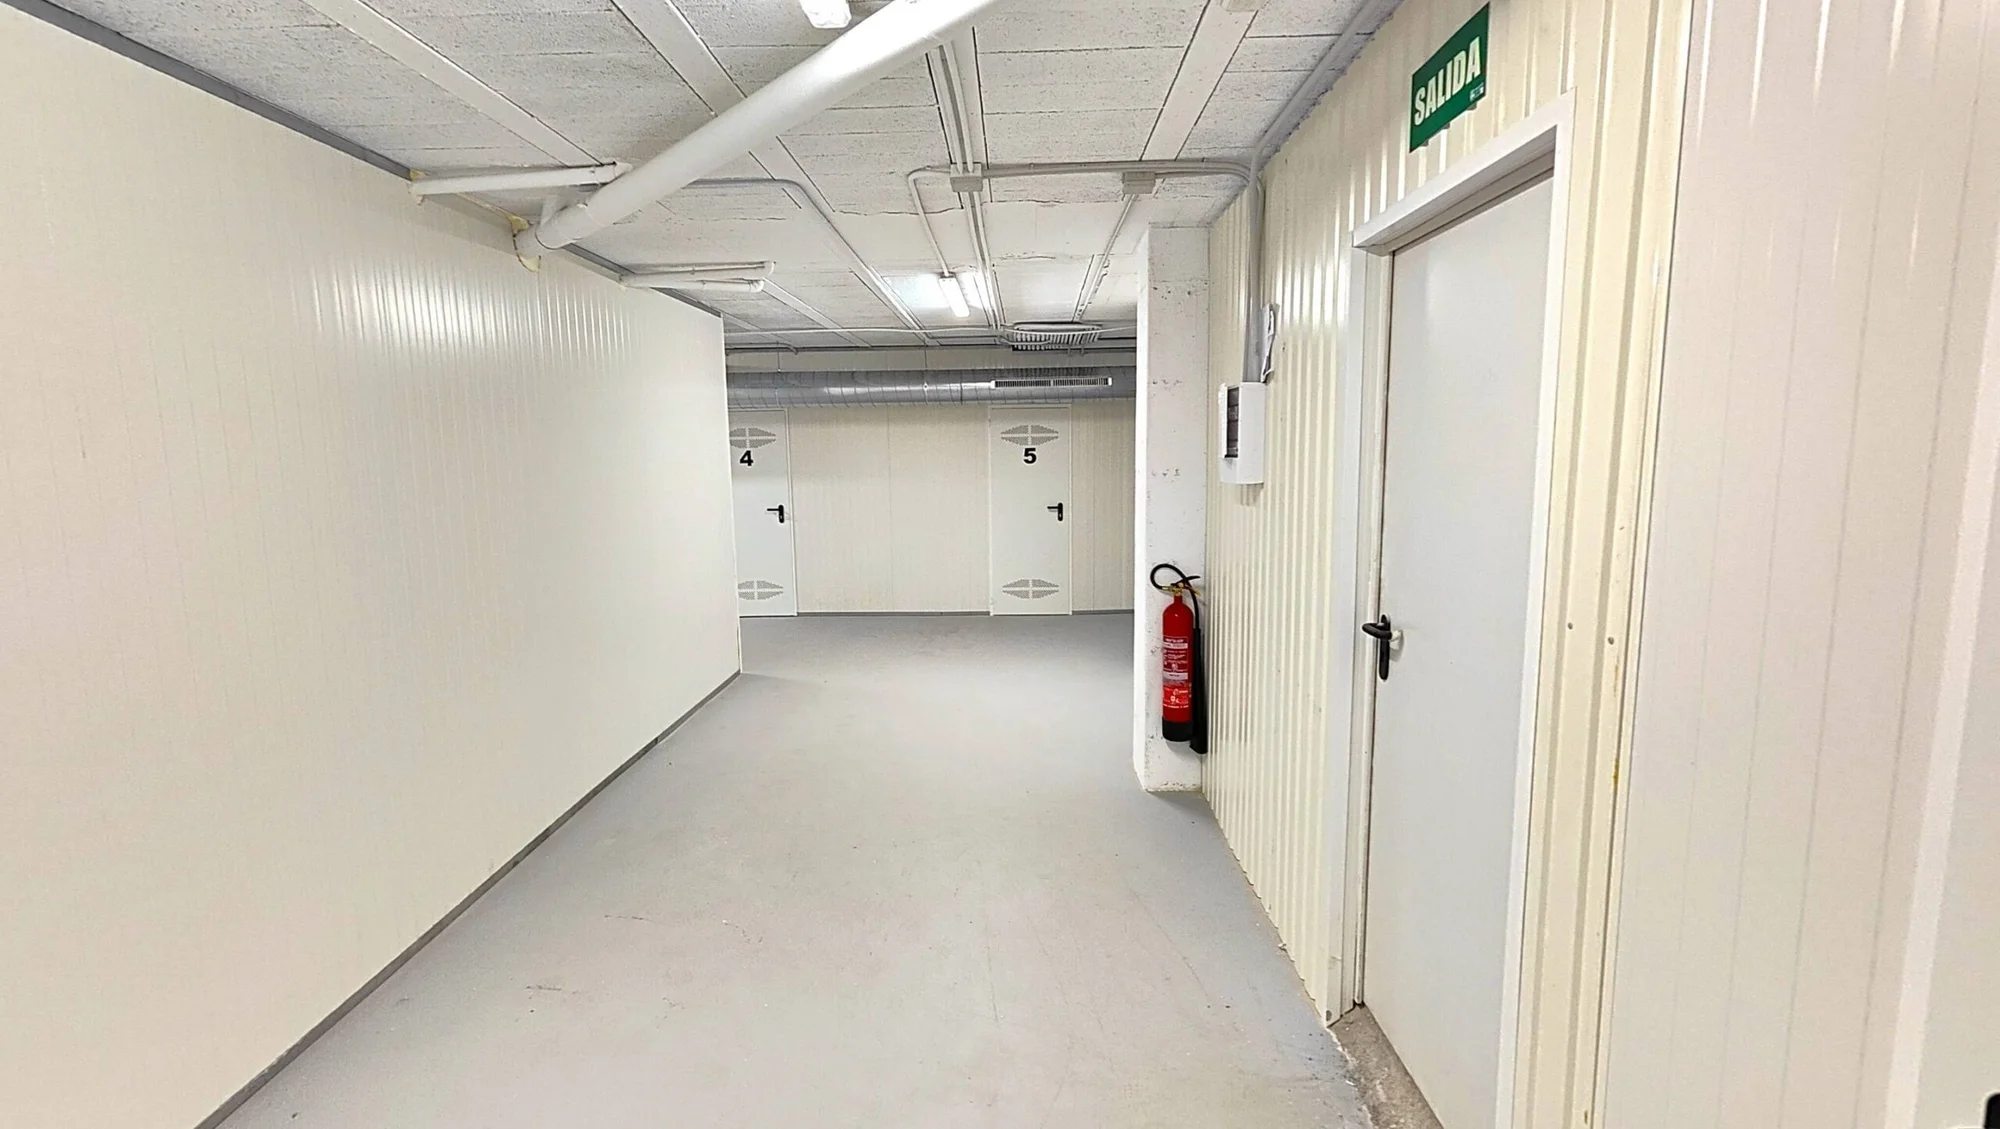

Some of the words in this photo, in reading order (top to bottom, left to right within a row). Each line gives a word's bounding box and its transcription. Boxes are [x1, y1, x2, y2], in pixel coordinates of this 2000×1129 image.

[1414, 36, 1481, 126] SALIDA
[739, 449, 754, 467] 4
[1023, 447, 1037, 465] 5
